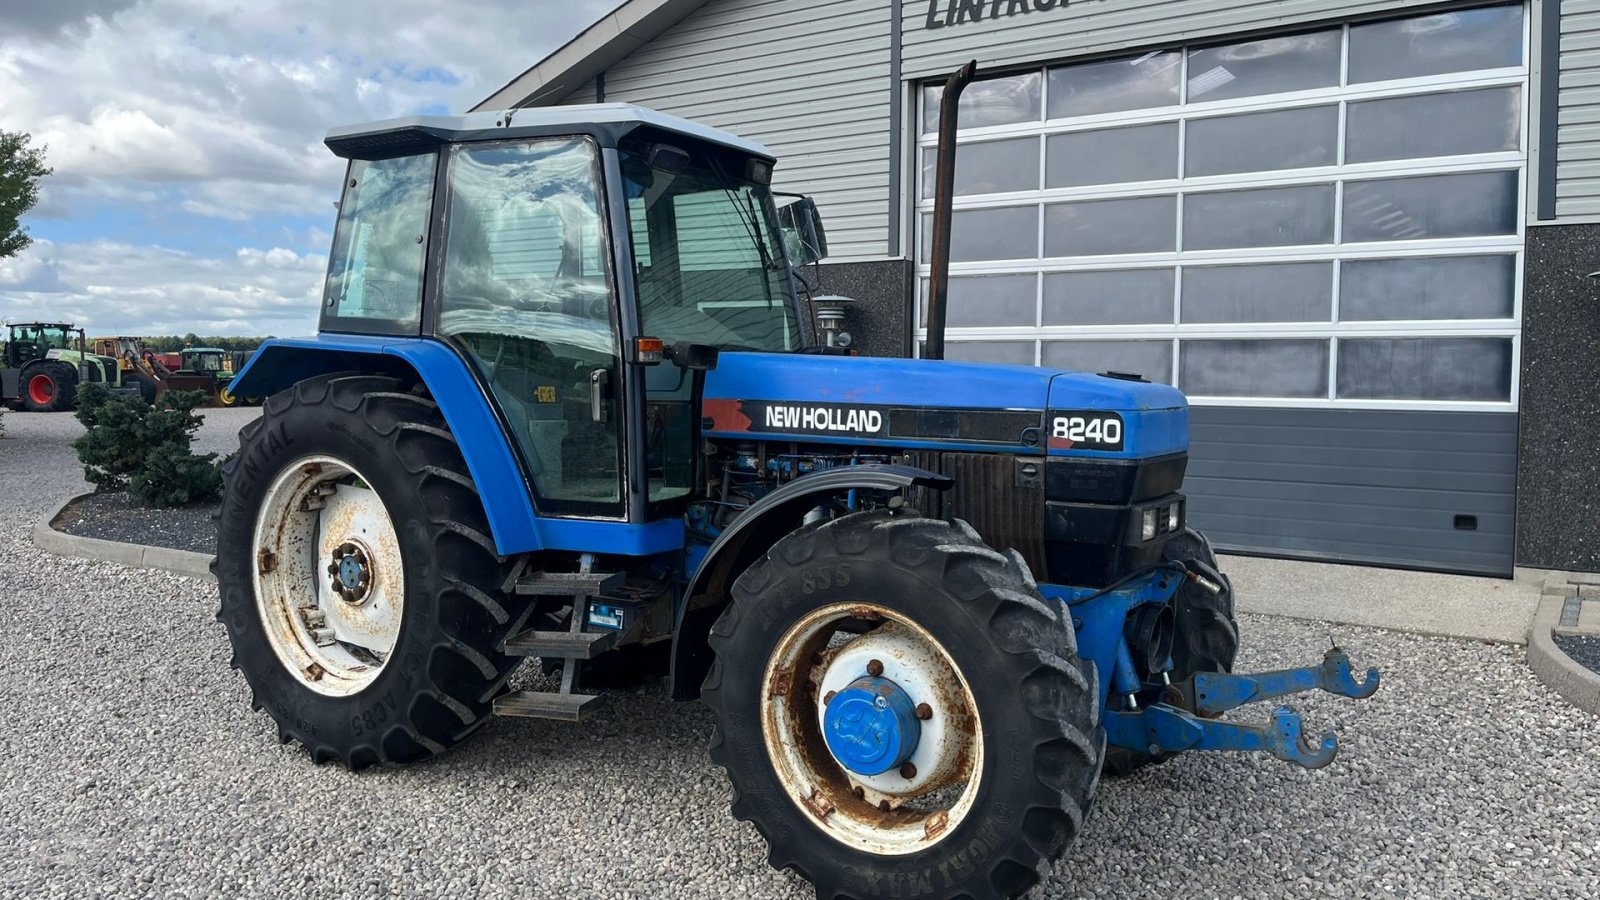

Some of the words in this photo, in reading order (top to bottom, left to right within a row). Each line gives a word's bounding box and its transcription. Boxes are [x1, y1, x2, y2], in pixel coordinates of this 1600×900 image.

[925, 0, 1070, 30] LINTR
[766, 405, 801, 428] NEW
[802, 407, 882, 433] HOLLAND
[1053, 417, 1121, 444] 8240
[801, 560, 851, 596] 855
[351, 688, 397, 737] AC85
